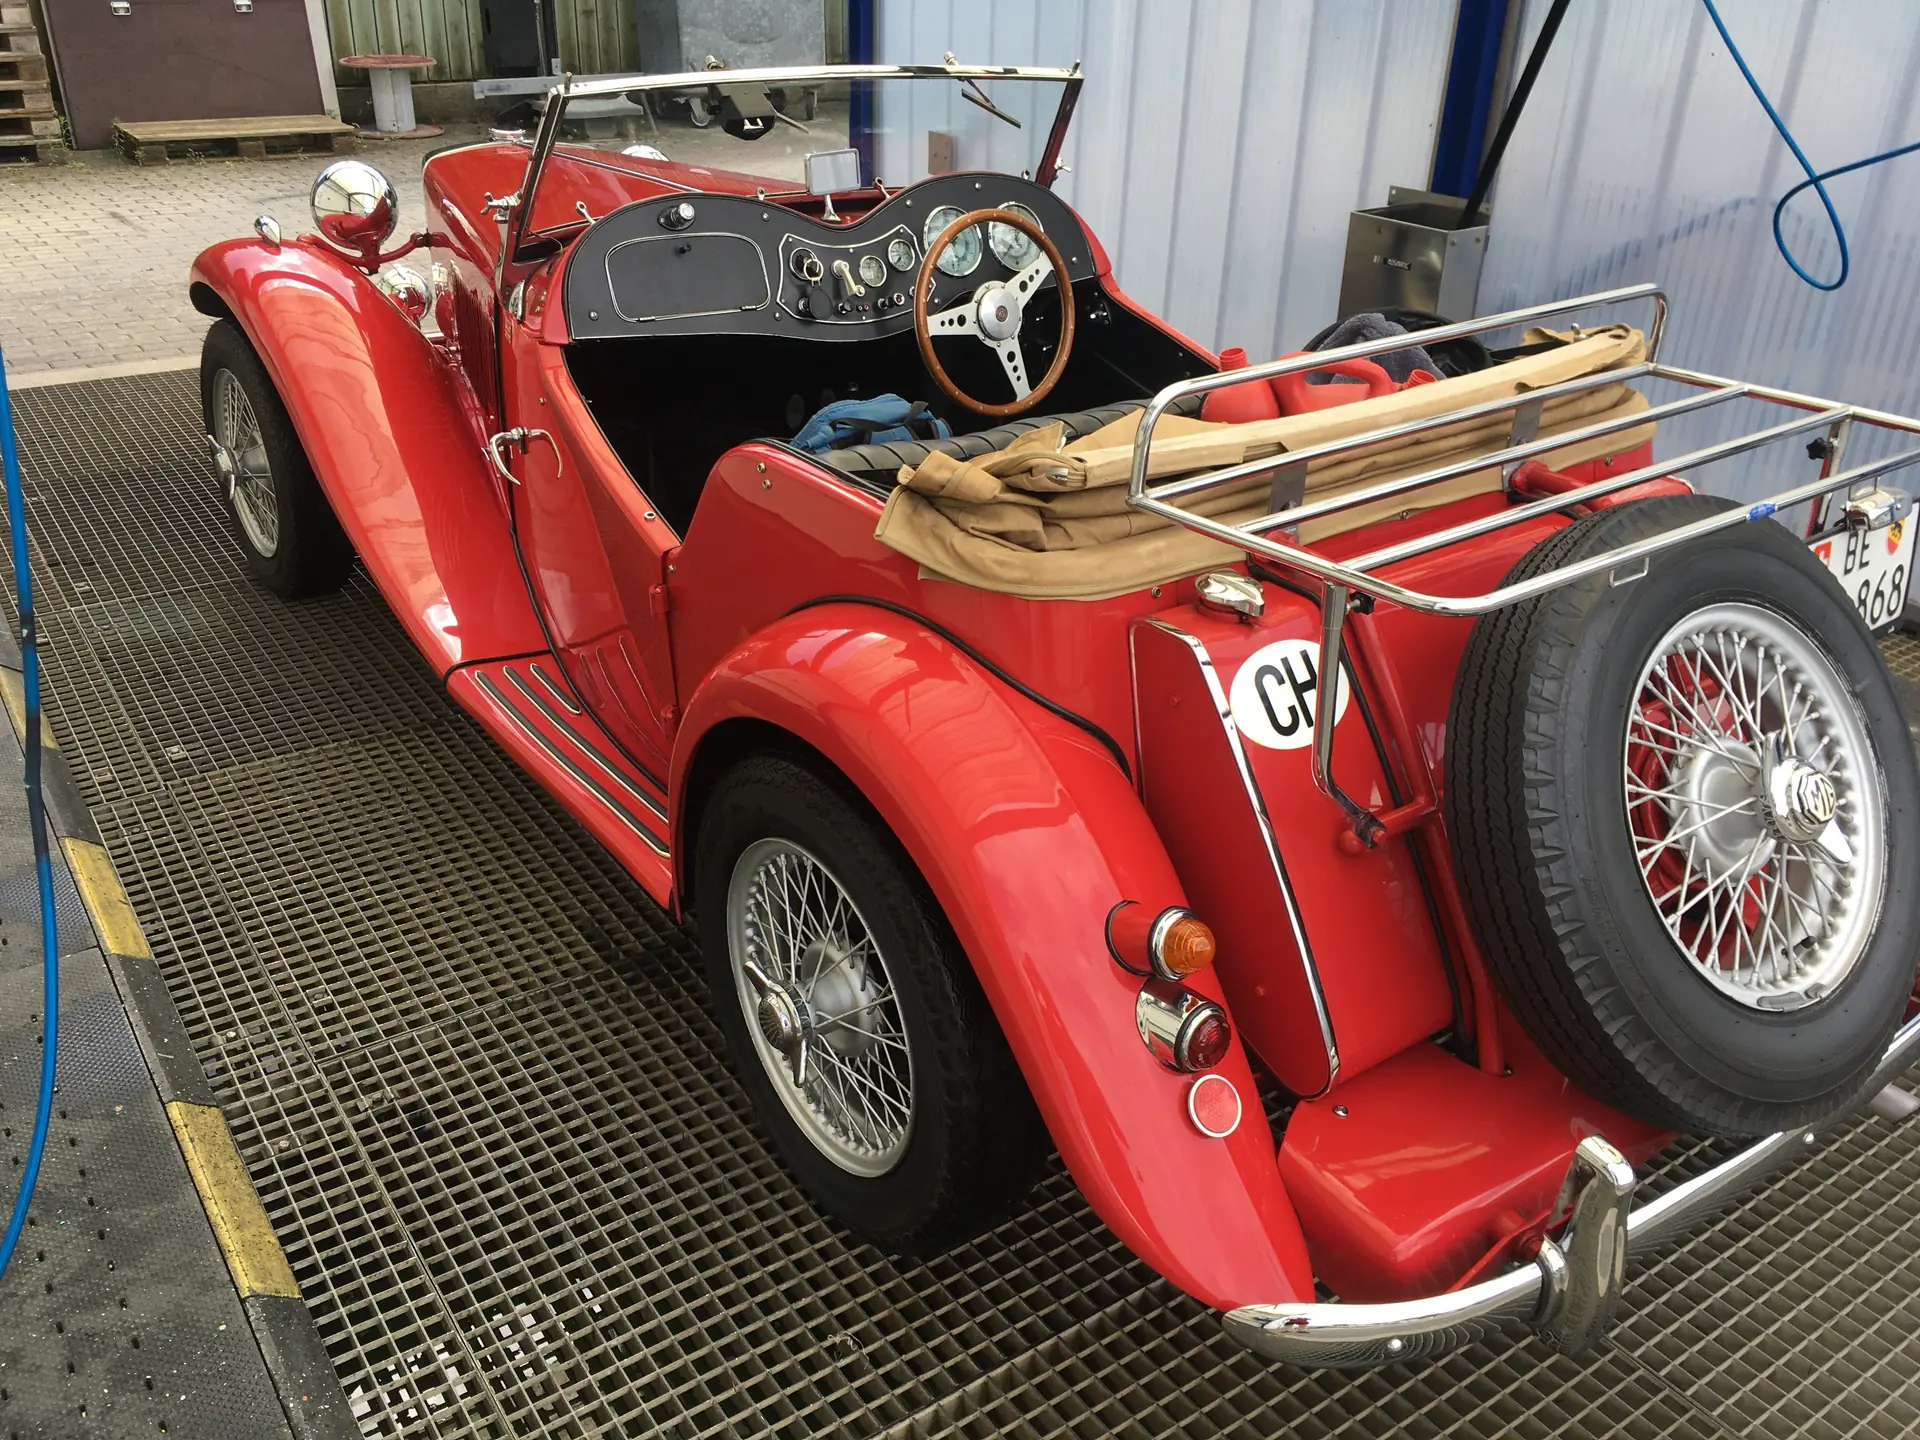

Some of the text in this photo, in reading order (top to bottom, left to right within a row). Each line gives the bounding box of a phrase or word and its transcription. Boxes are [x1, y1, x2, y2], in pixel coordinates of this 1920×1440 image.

[1844, 530, 1870, 576] BE
[1856, 564, 1904, 625] 868
[1255, 649, 1317, 737] CH
[1811, 777, 1835, 817] MG
